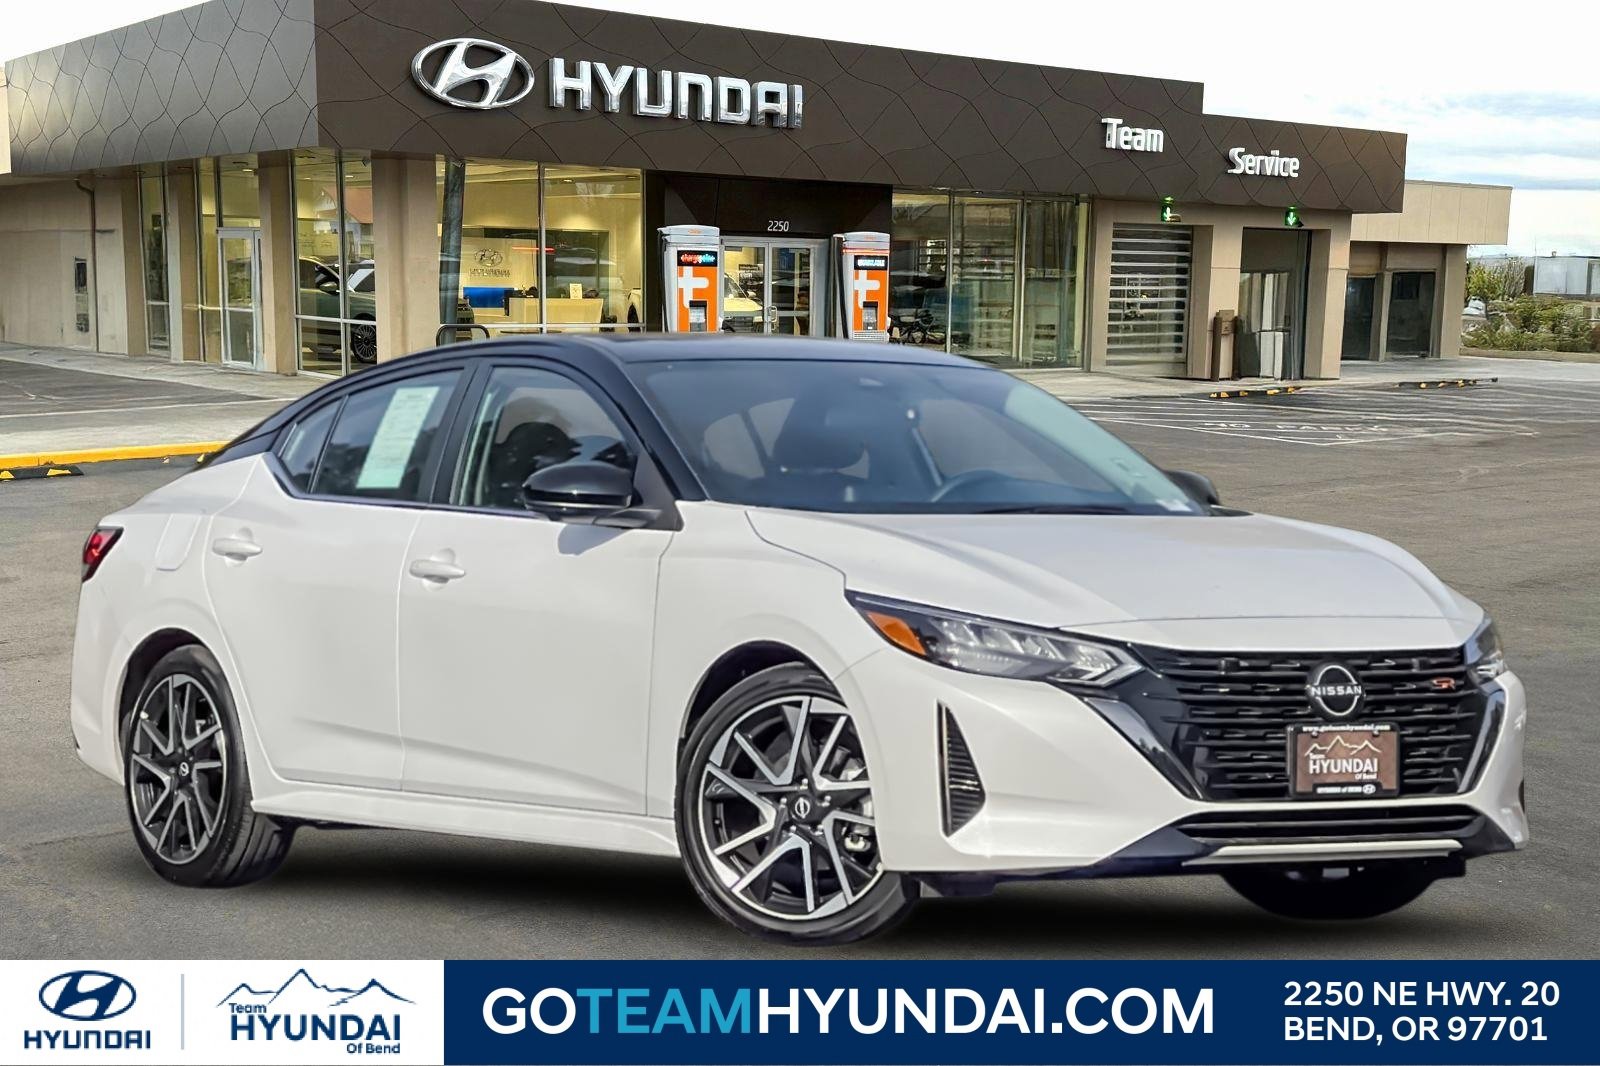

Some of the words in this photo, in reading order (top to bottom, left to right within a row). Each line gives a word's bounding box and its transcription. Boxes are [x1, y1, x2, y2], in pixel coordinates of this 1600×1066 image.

[549, 57, 803, 129] HYUNDAI
[1101, 117, 1164, 153] Team
[1227, 147, 1300, 178] Service
[767, 220, 789, 232] 2250
[1311, 685, 1362, 696] NISSAN
[1309, 758, 1378, 774] HYUNDAI
